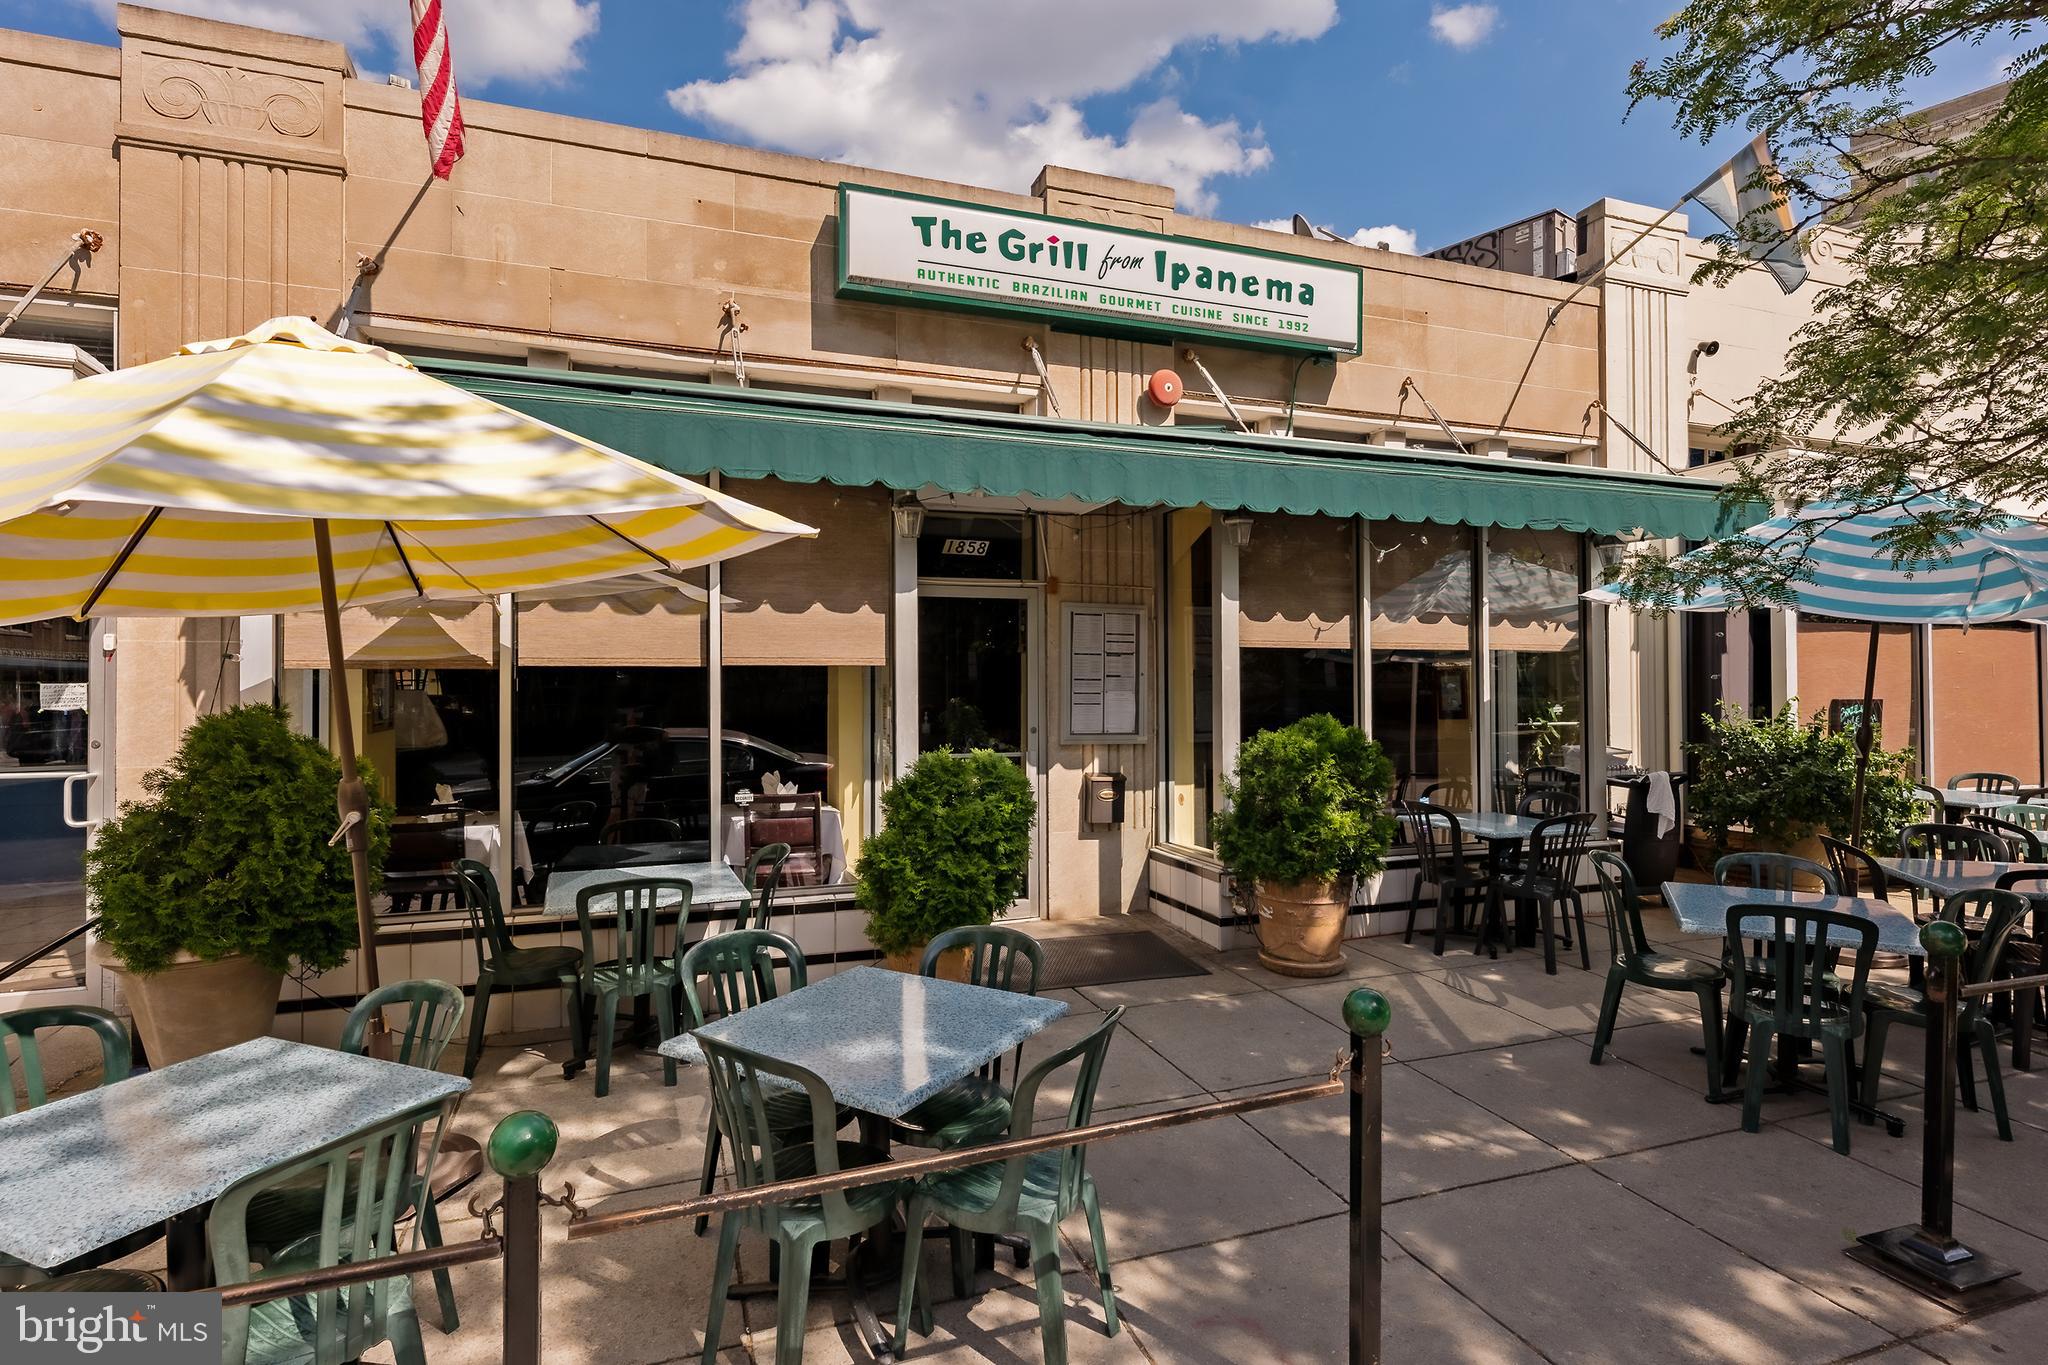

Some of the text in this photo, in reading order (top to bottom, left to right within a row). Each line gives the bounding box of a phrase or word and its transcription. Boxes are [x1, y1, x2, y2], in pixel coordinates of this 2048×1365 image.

[911, 216, 1315, 306] The Grill from Ipanema
[917, 268, 1309, 333] AUTHENTIC BRAZILIAN GOURMET CUISINE SINCE 1992
[947, 540, 986, 554] 1858
